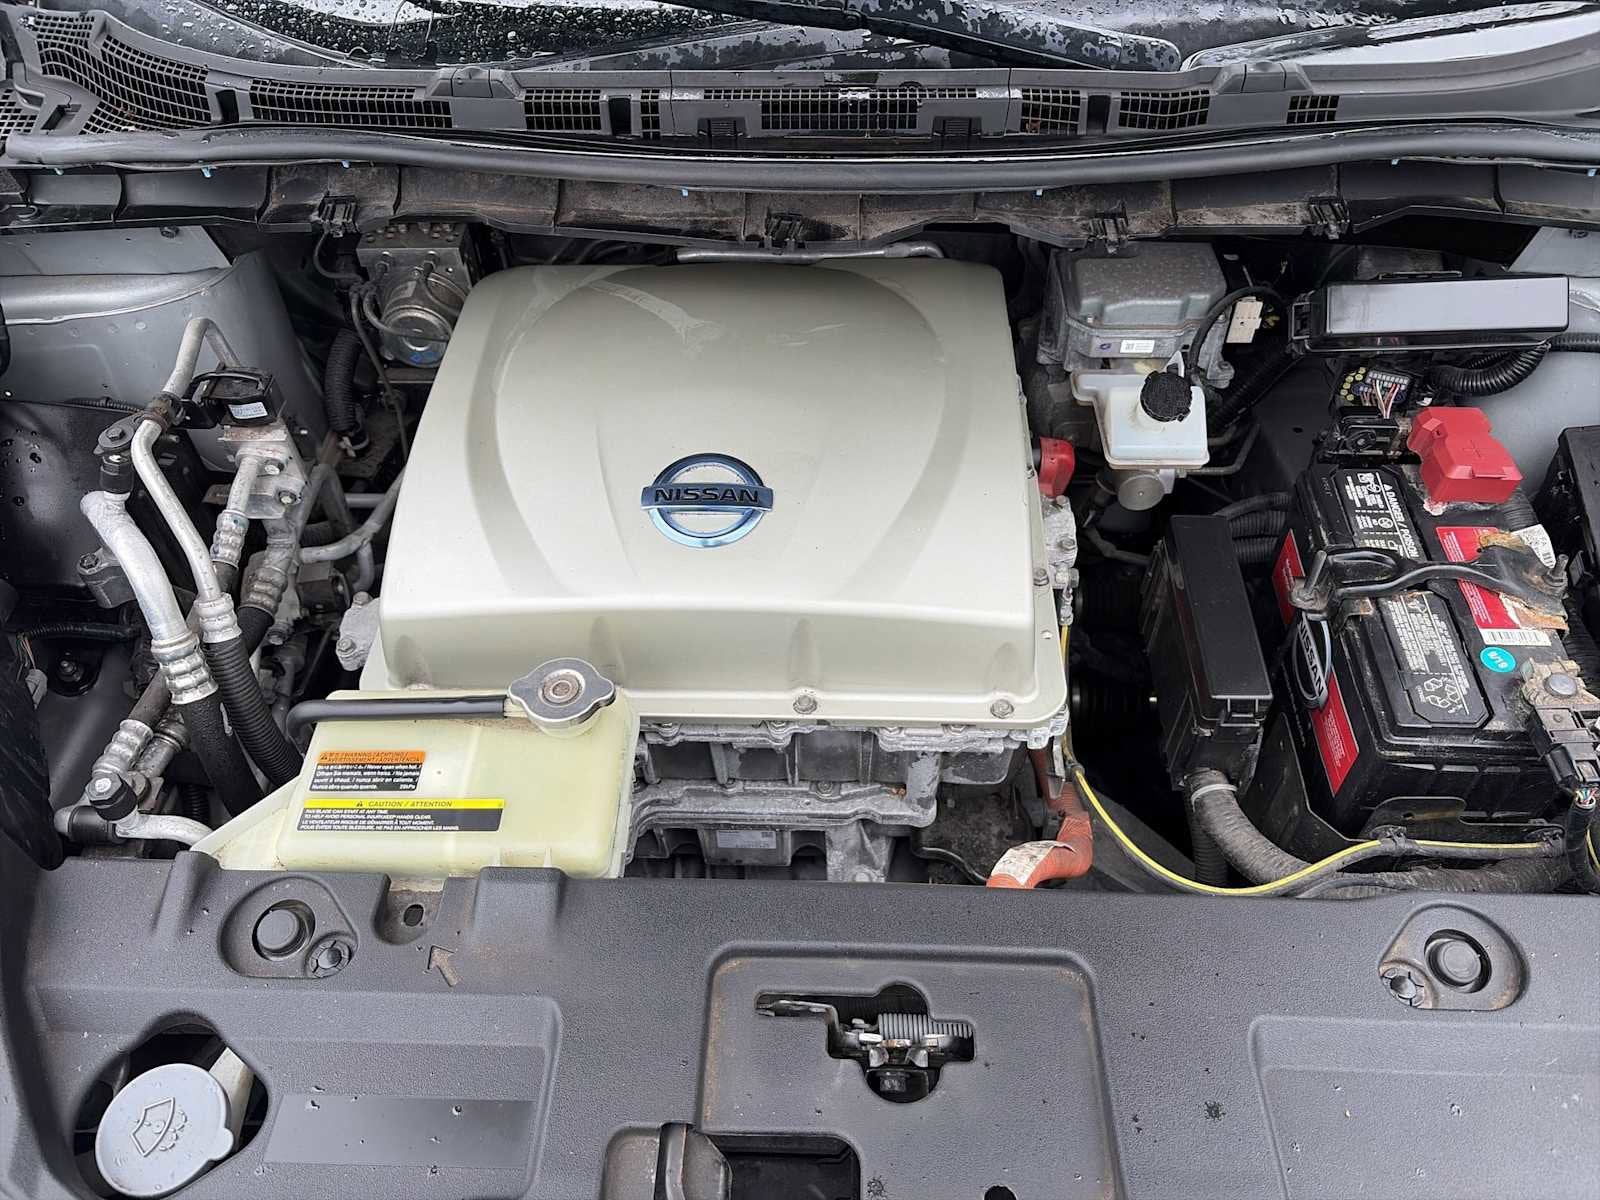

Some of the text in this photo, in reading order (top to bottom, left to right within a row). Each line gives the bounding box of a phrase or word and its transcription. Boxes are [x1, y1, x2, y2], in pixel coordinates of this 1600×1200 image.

[654, 487, 759, 503] NISSAN
[1386, 491, 1405, 522] DANGER
[1400, 528, 1420, 558] POISON
[1300, 620, 1324, 697] NISSAN
